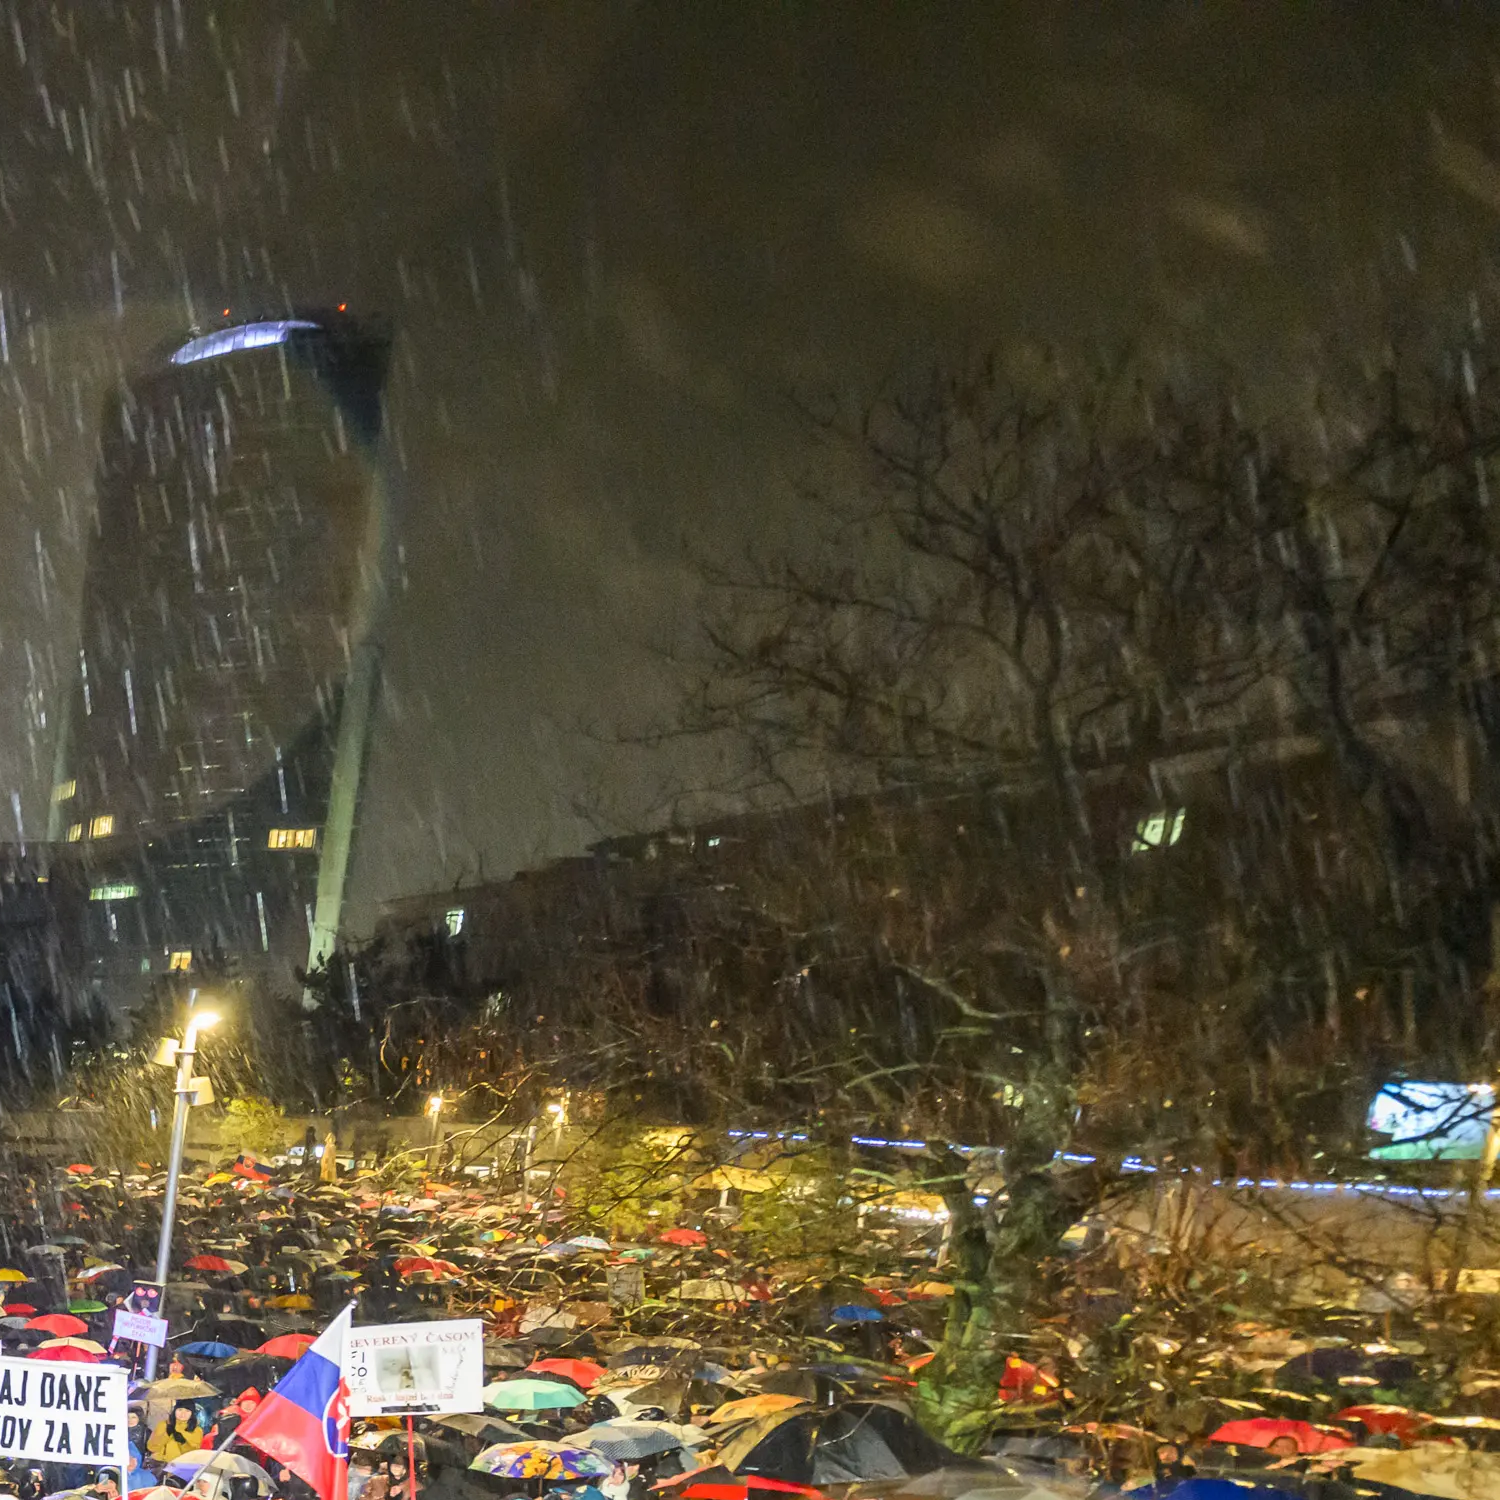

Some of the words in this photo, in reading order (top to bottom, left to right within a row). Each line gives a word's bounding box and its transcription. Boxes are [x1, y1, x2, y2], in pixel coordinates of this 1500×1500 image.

[40, 1372, 111, 1413] DANE
[44, 1419, 73, 1455] ZA
[83, 1424, 117, 1458] NE
